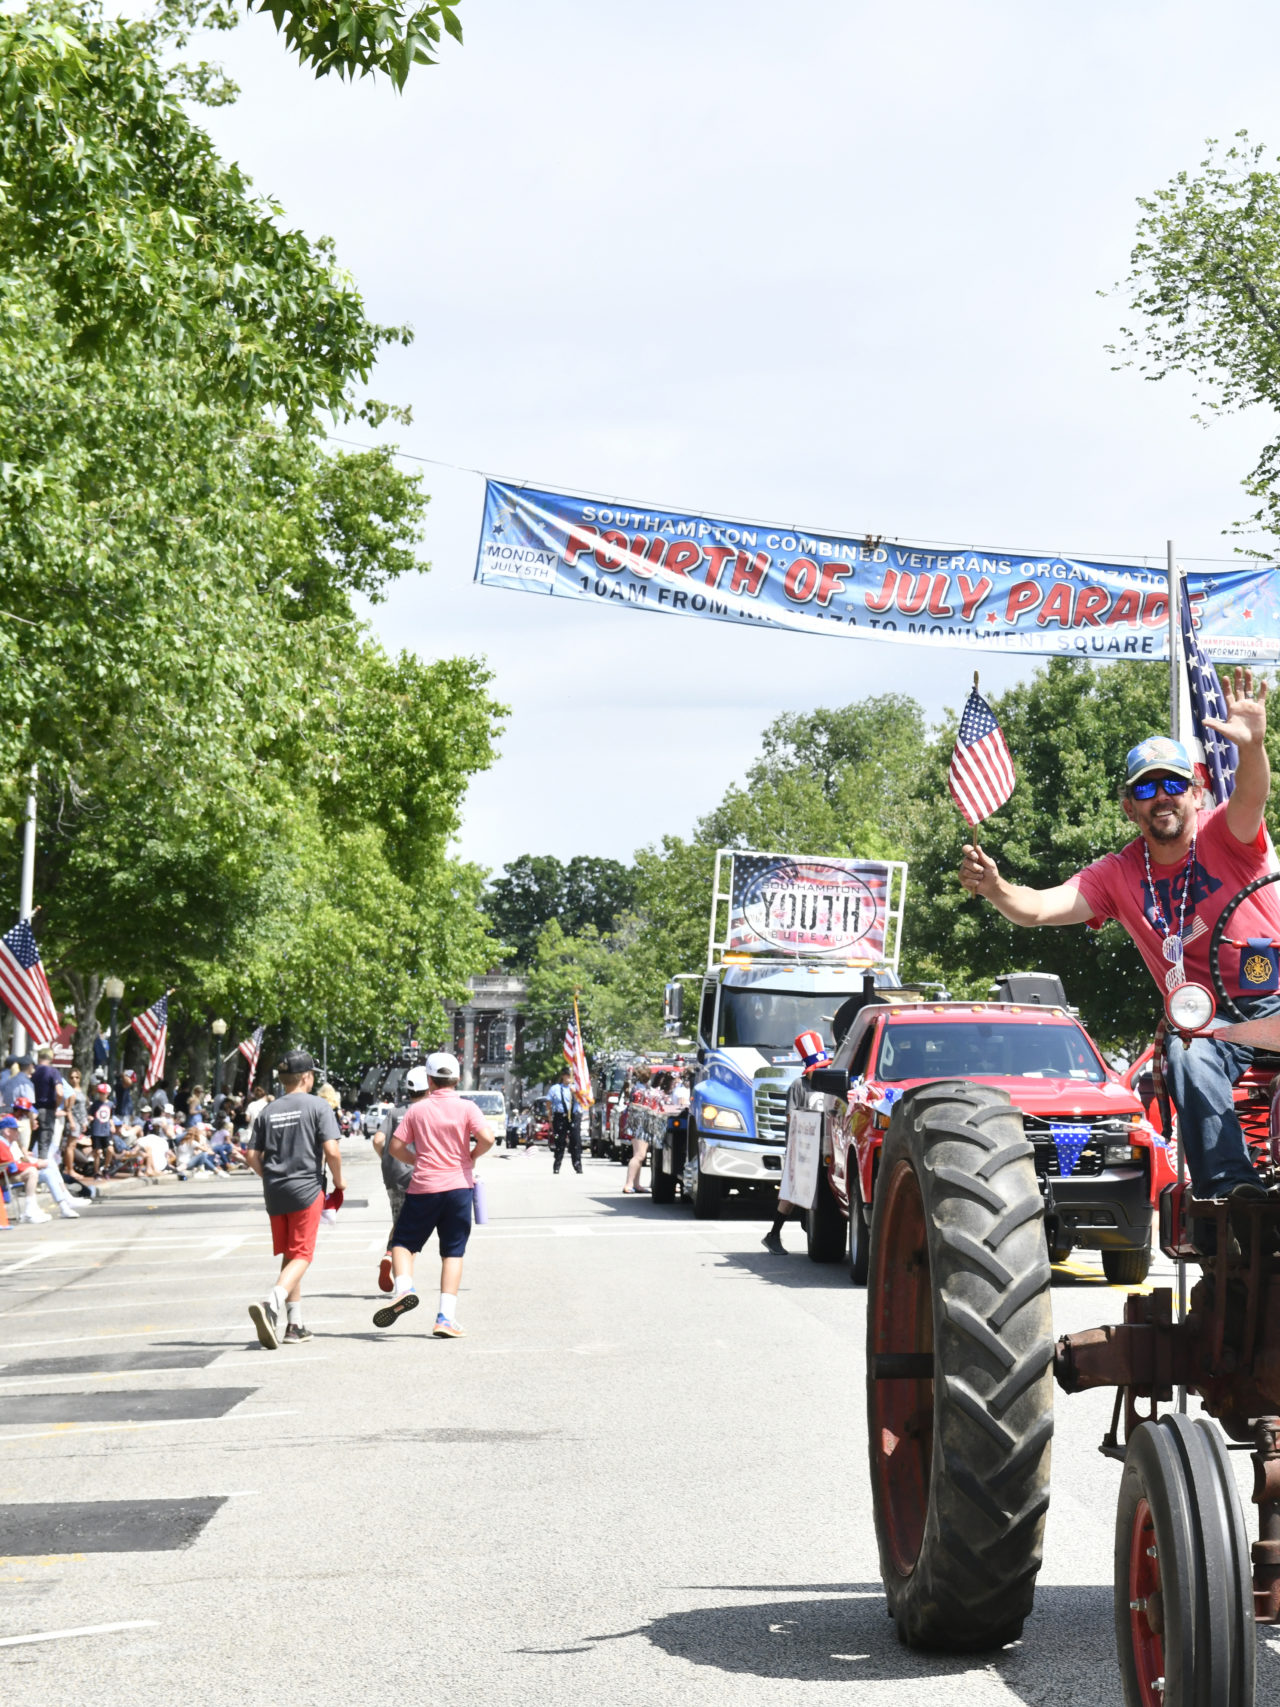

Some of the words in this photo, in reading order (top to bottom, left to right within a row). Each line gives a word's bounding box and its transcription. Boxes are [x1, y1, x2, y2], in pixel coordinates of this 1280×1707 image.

[486, 545, 556, 566] MONDAY
[581, 506, 757, 547] SOUTHAMPTON
[766, 534, 889, 563] COMBINED
[896, 551, 1012, 575] VETERANS
[1019, 561, 1168, 587] ORGANIZATIO
[491, 561, 522, 573] JULY
[525, 566, 549, 577] 5TH
[562, 523, 772, 598] FOURTH
[783, 557, 853, 608] OF
[864, 567, 993, 622] JULY
[578, 575, 647, 603] 10AM
[658, 587, 728, 616] FROM
[908, 622, 1049, 649] MONUMENT
[1058, 634, 1154, 654] SQUARE
[761, 882, 860, 894] SOUTHAMPTON
[1141, 860, 1223, 929] USA
[760, 892, 861, 932] YOUTH
[771, 931, 843, 941] BUREAU
